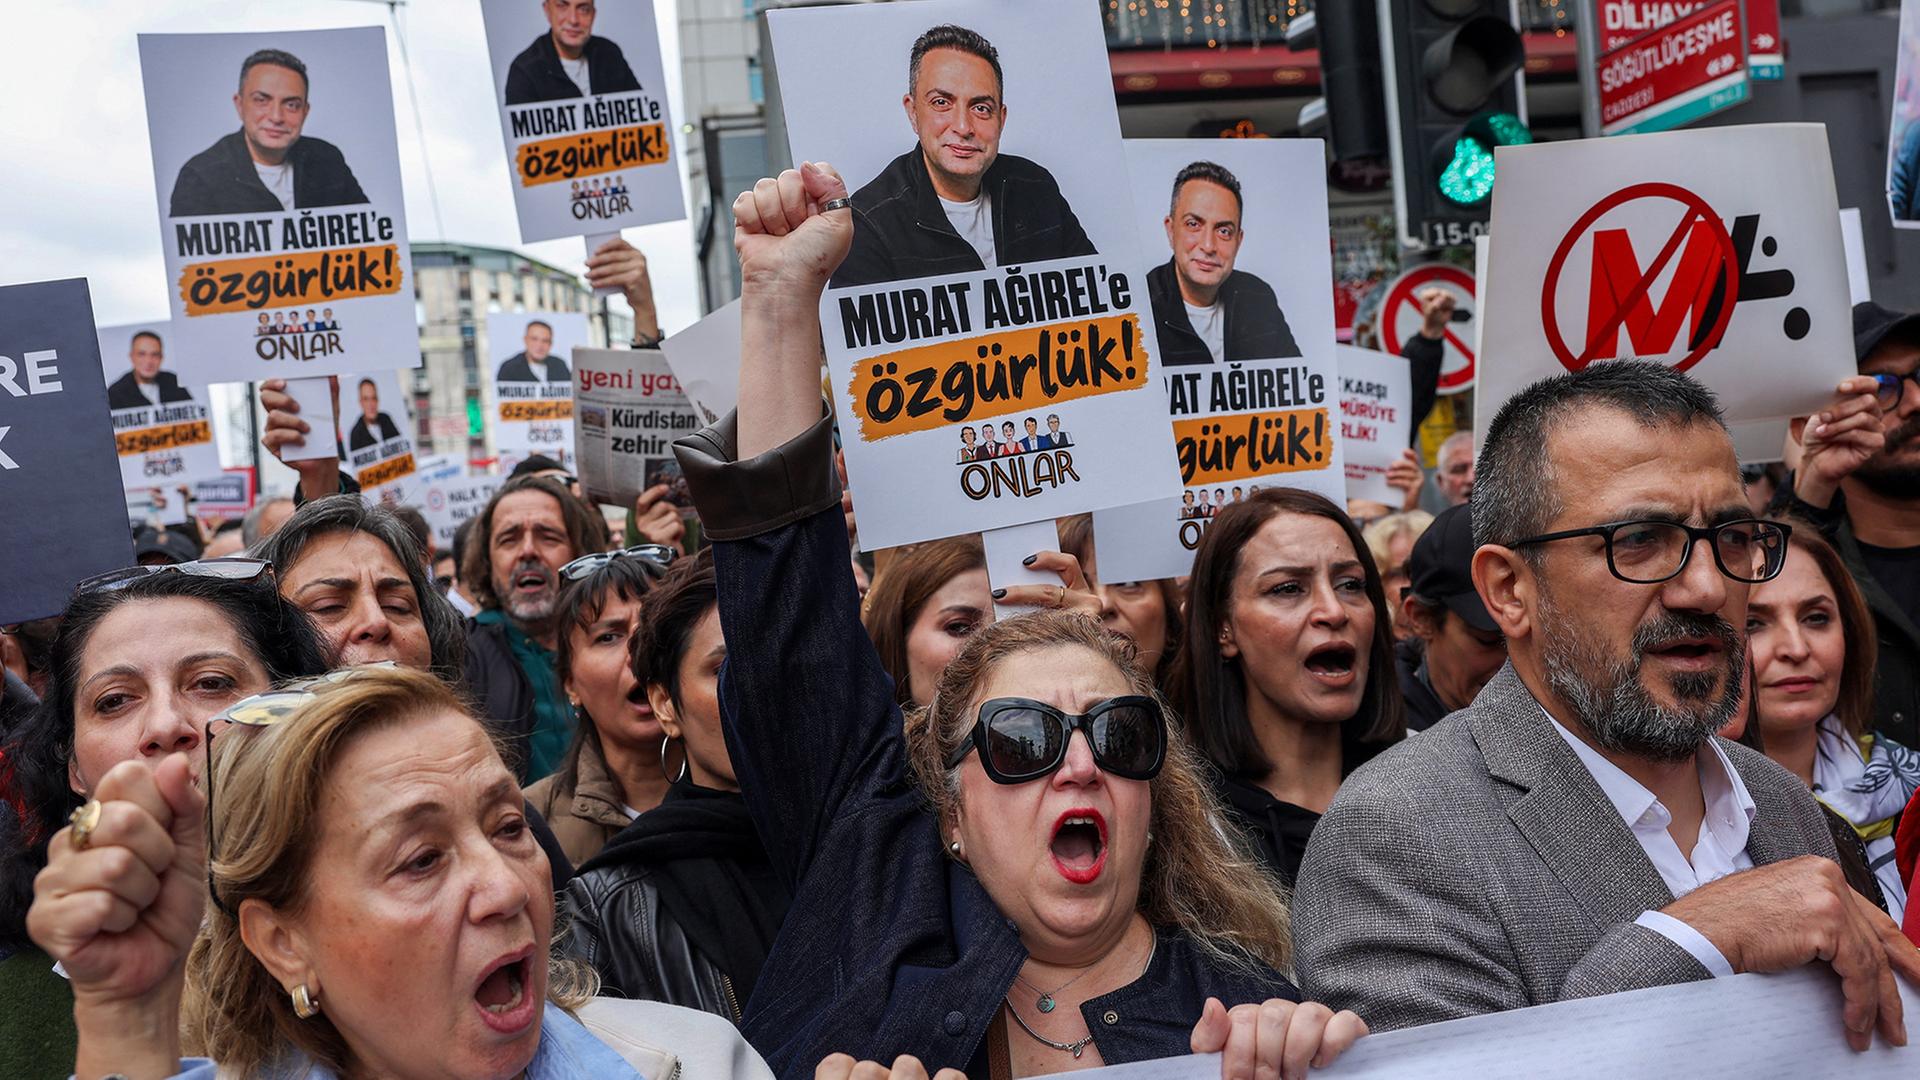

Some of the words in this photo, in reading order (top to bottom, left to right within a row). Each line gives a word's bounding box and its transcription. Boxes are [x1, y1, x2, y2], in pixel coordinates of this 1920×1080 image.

[1605, 0, 1706, 30] DİLHAY
[1602, 10, 1736, 92] SÖĞÜTLÜÇEŞME
[510, 104, 577, 138] MURAT
[524, 127, 663, 178] özgürlük!
[571, 194, 633, 220] ONLAR
[175, 219, 272, 257] MURAT
[1433, 221, 1491, 246] 15-0
[190, 248, 394, 308] özgürlük!
[838, 281, 972, 349] MURAT
[255, 332, 344, 361] ONLAR
[579, 368, 634, 392] yeni
[865, 319, 1137, 424] özgürlük!
[1163, 372, 1201, 416] AT
[611, 434, 667, 455] zehir
[1176, 411, 1324, 486] gürlük!
[960, 450, 1080, 500] ONLAR
